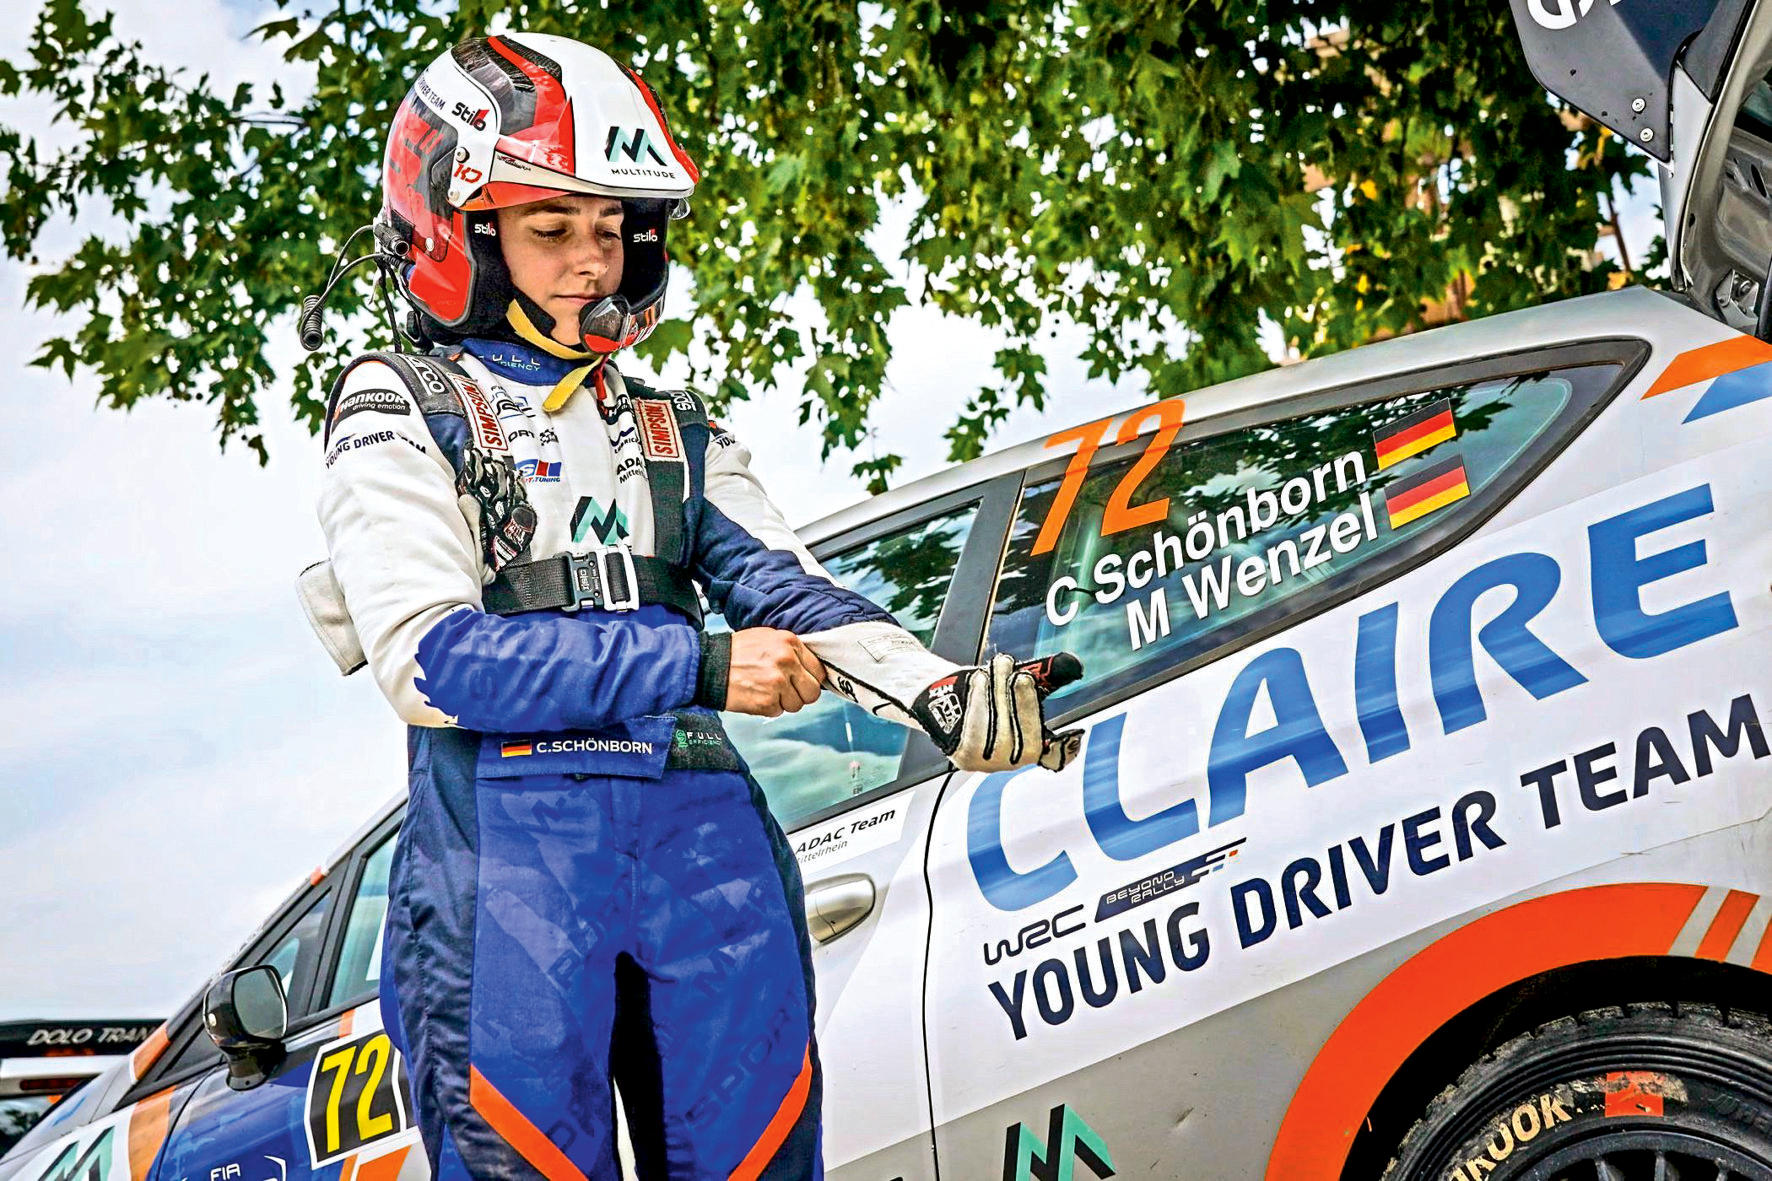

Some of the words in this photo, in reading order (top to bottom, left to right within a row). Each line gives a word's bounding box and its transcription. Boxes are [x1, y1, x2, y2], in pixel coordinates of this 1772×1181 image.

[428, 90, 446, 110] TEAM
[452, 102, 489, 131] Stilo
[610, 168, 676, 179] MULTITUDE
[352, 402, 376, 411] driving
[461, 380, 502, 446] SIMPSON
[353, 430, 395, 449] DRIVER
[643, 400, 674, 455] SIMPSON
[1030, 399, 1186, 557] 72
[1045, 575, 1080, 627] C
[1092, 450, 1366, 605] Schönborn
[1125, 587, 1171, 652] M
[1182, 491, 1379, 620] Wenzel
[967, 483, 1739, 912] CLAIRE
[536, 737, 653, 755] C.SCHÖNBORN
[795, 827, 846, 855] ADAC
[850, 809, 896, 834] Team
[797, 839, 848, 864] ittelrhein
[987, 901, 1211, 1041] YOUNG
[1230, 790, 1507, 950] DRIVER
[1520, 693, 1772, 830] TEAM
[1106, 870, 1175, 905] BEYOND
[1131, 875, 1185, 904] RALLY
[984, 904, 1086, 966] WRC
[27, 1028, 93, 1046] DOLO
[320, 1034, 394, 1153] 72
[210, 1163, 242, 1181] FIA
